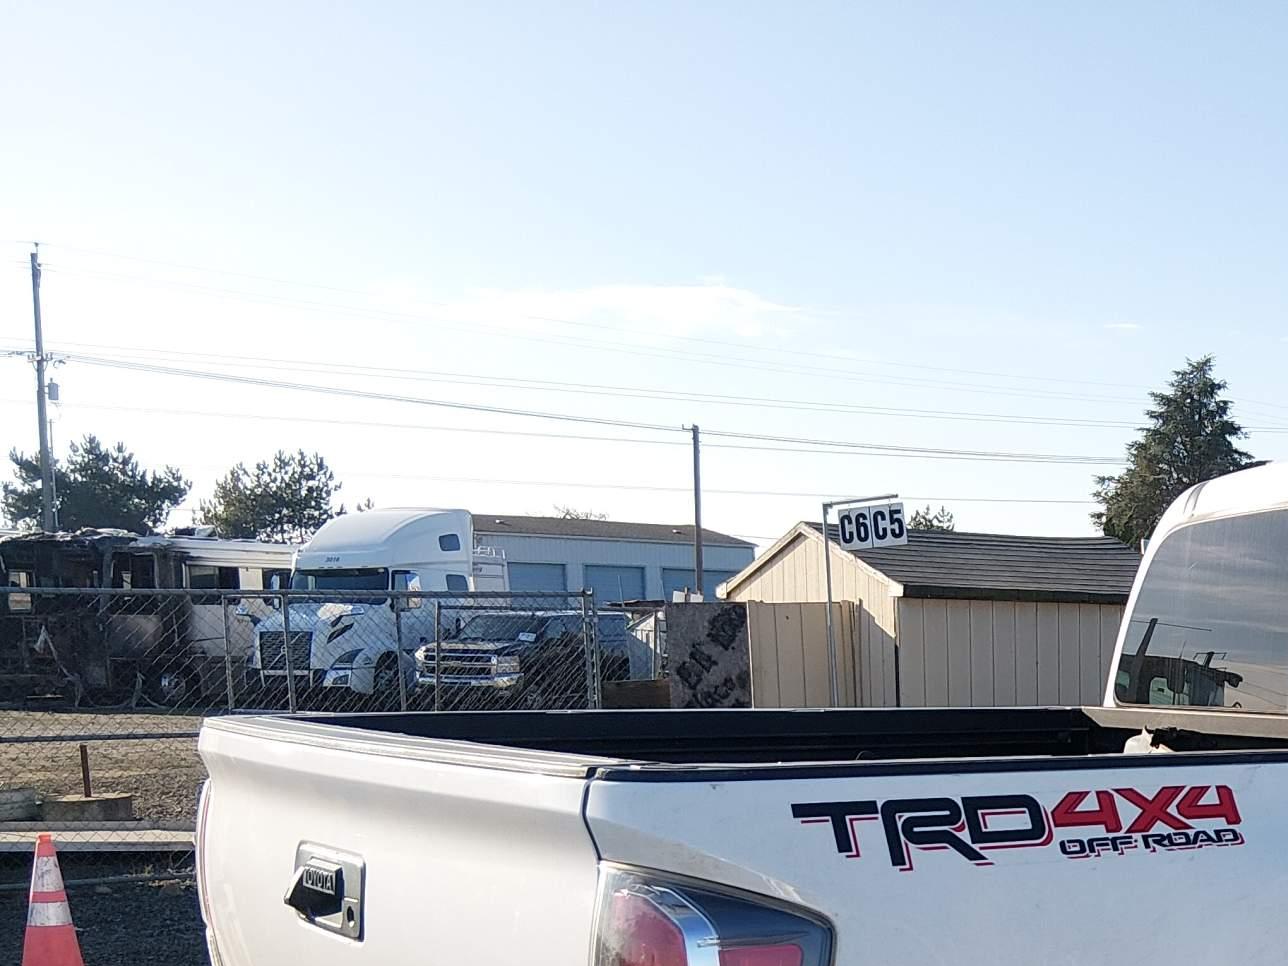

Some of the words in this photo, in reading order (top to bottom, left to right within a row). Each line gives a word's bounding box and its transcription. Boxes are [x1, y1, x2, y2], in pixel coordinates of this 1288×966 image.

[791, 794, 1053, 871] TRD
[1050, 785, 1242, 834] 4X4
[1059, 834, 1138, 859] OFF
[1141, 827, 1245, 853] ROAD
[303, 867, 336, 893] TOYOTA
